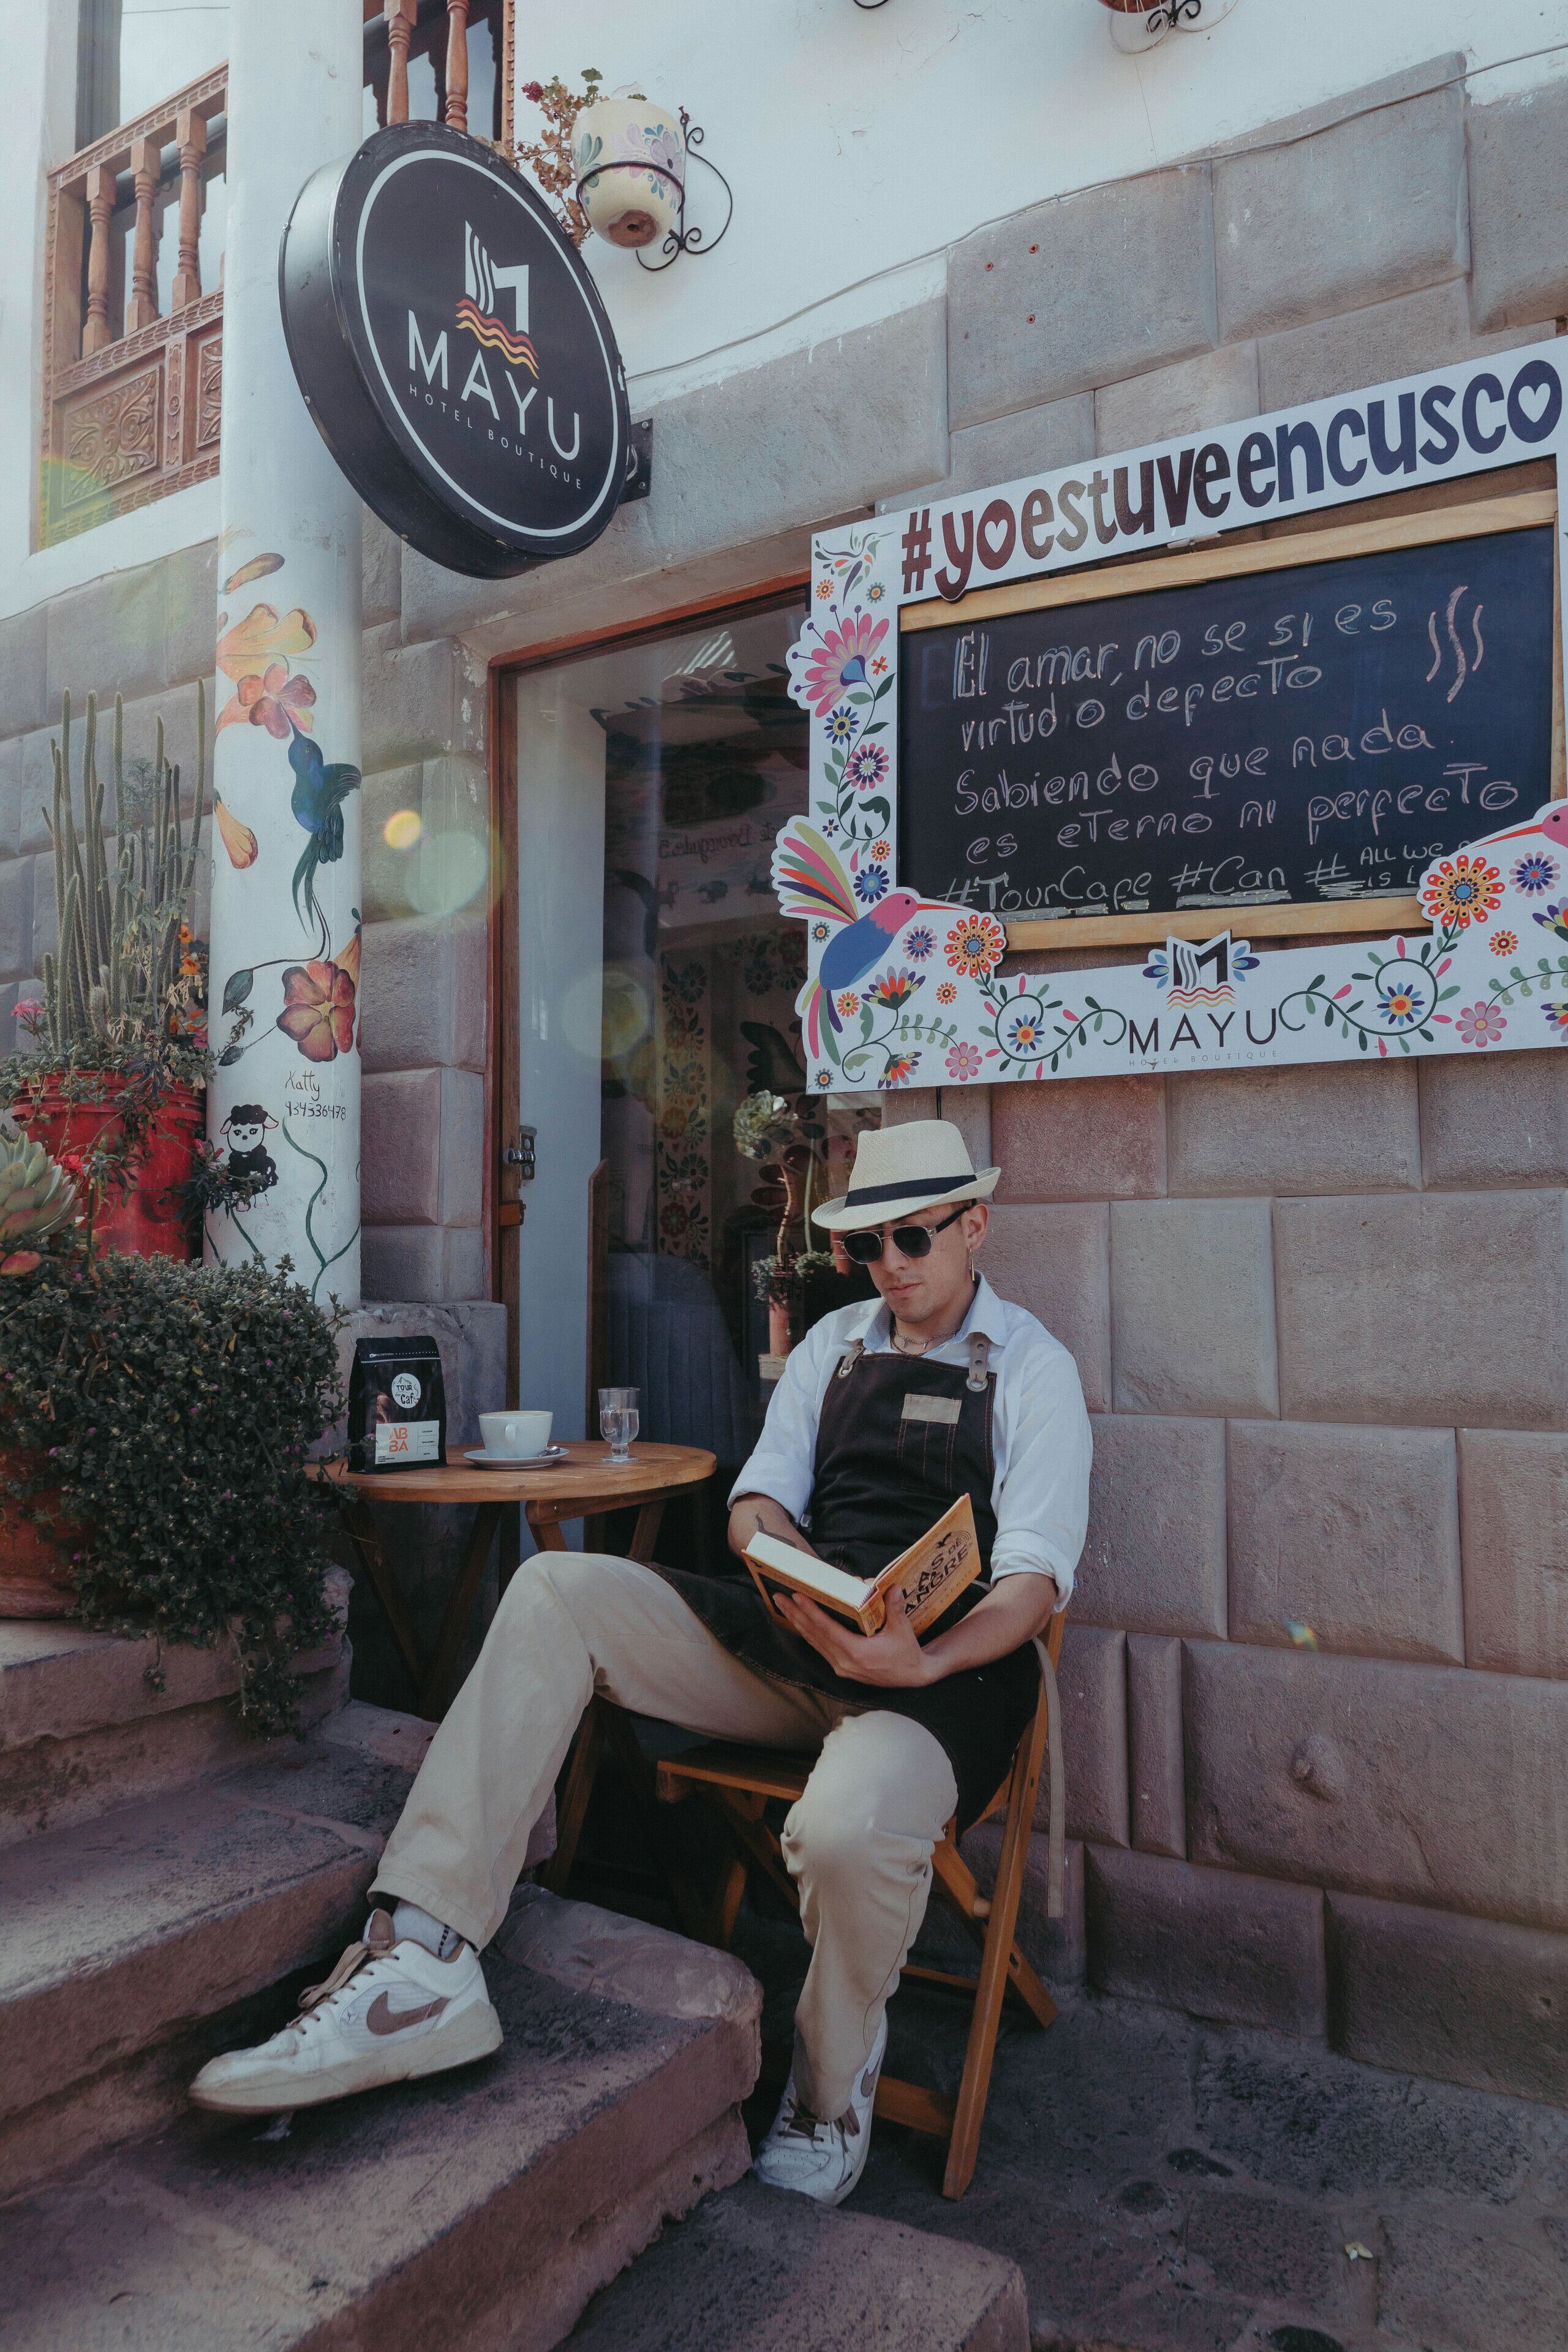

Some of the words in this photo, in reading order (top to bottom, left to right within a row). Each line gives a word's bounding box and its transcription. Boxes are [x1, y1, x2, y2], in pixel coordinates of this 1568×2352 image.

[408, 309, 580, 461] MAYU
[409, 383, 472, 429] HOTEL
[488, 429, 581, 489] BOUTIQUE
[901, 359, 1562, 602] #yoestuveencusco
[953, 631, 989, 700] El
[1134, 630, 1182, 670] no
[1201, 622, 1246, 656] se
[1335, 599, 1397, 635] es
[1076, 698, 1106, 729] o
[955, 752, 1159, 815] Sabiendo
[1189, 747, 1269, 799] que
[967, 832, 1018, 864] es
[1360, 846, 1396, 865] ALL
[1168, 856, 1286, 895] #Can
[1129, 1008, 1276, 1056] MAYU
[1129, 1057, 1178, 1067] HOTEL
[1191, 1050, 1277, 1063] BOUTIQUE
[285, 1069, 320, 1101] Katty
[388, 1439, 409, 1452] BA
[389, 1427, 409, 1440] AB
[904, 1548, 968, 1615] ANGRE
